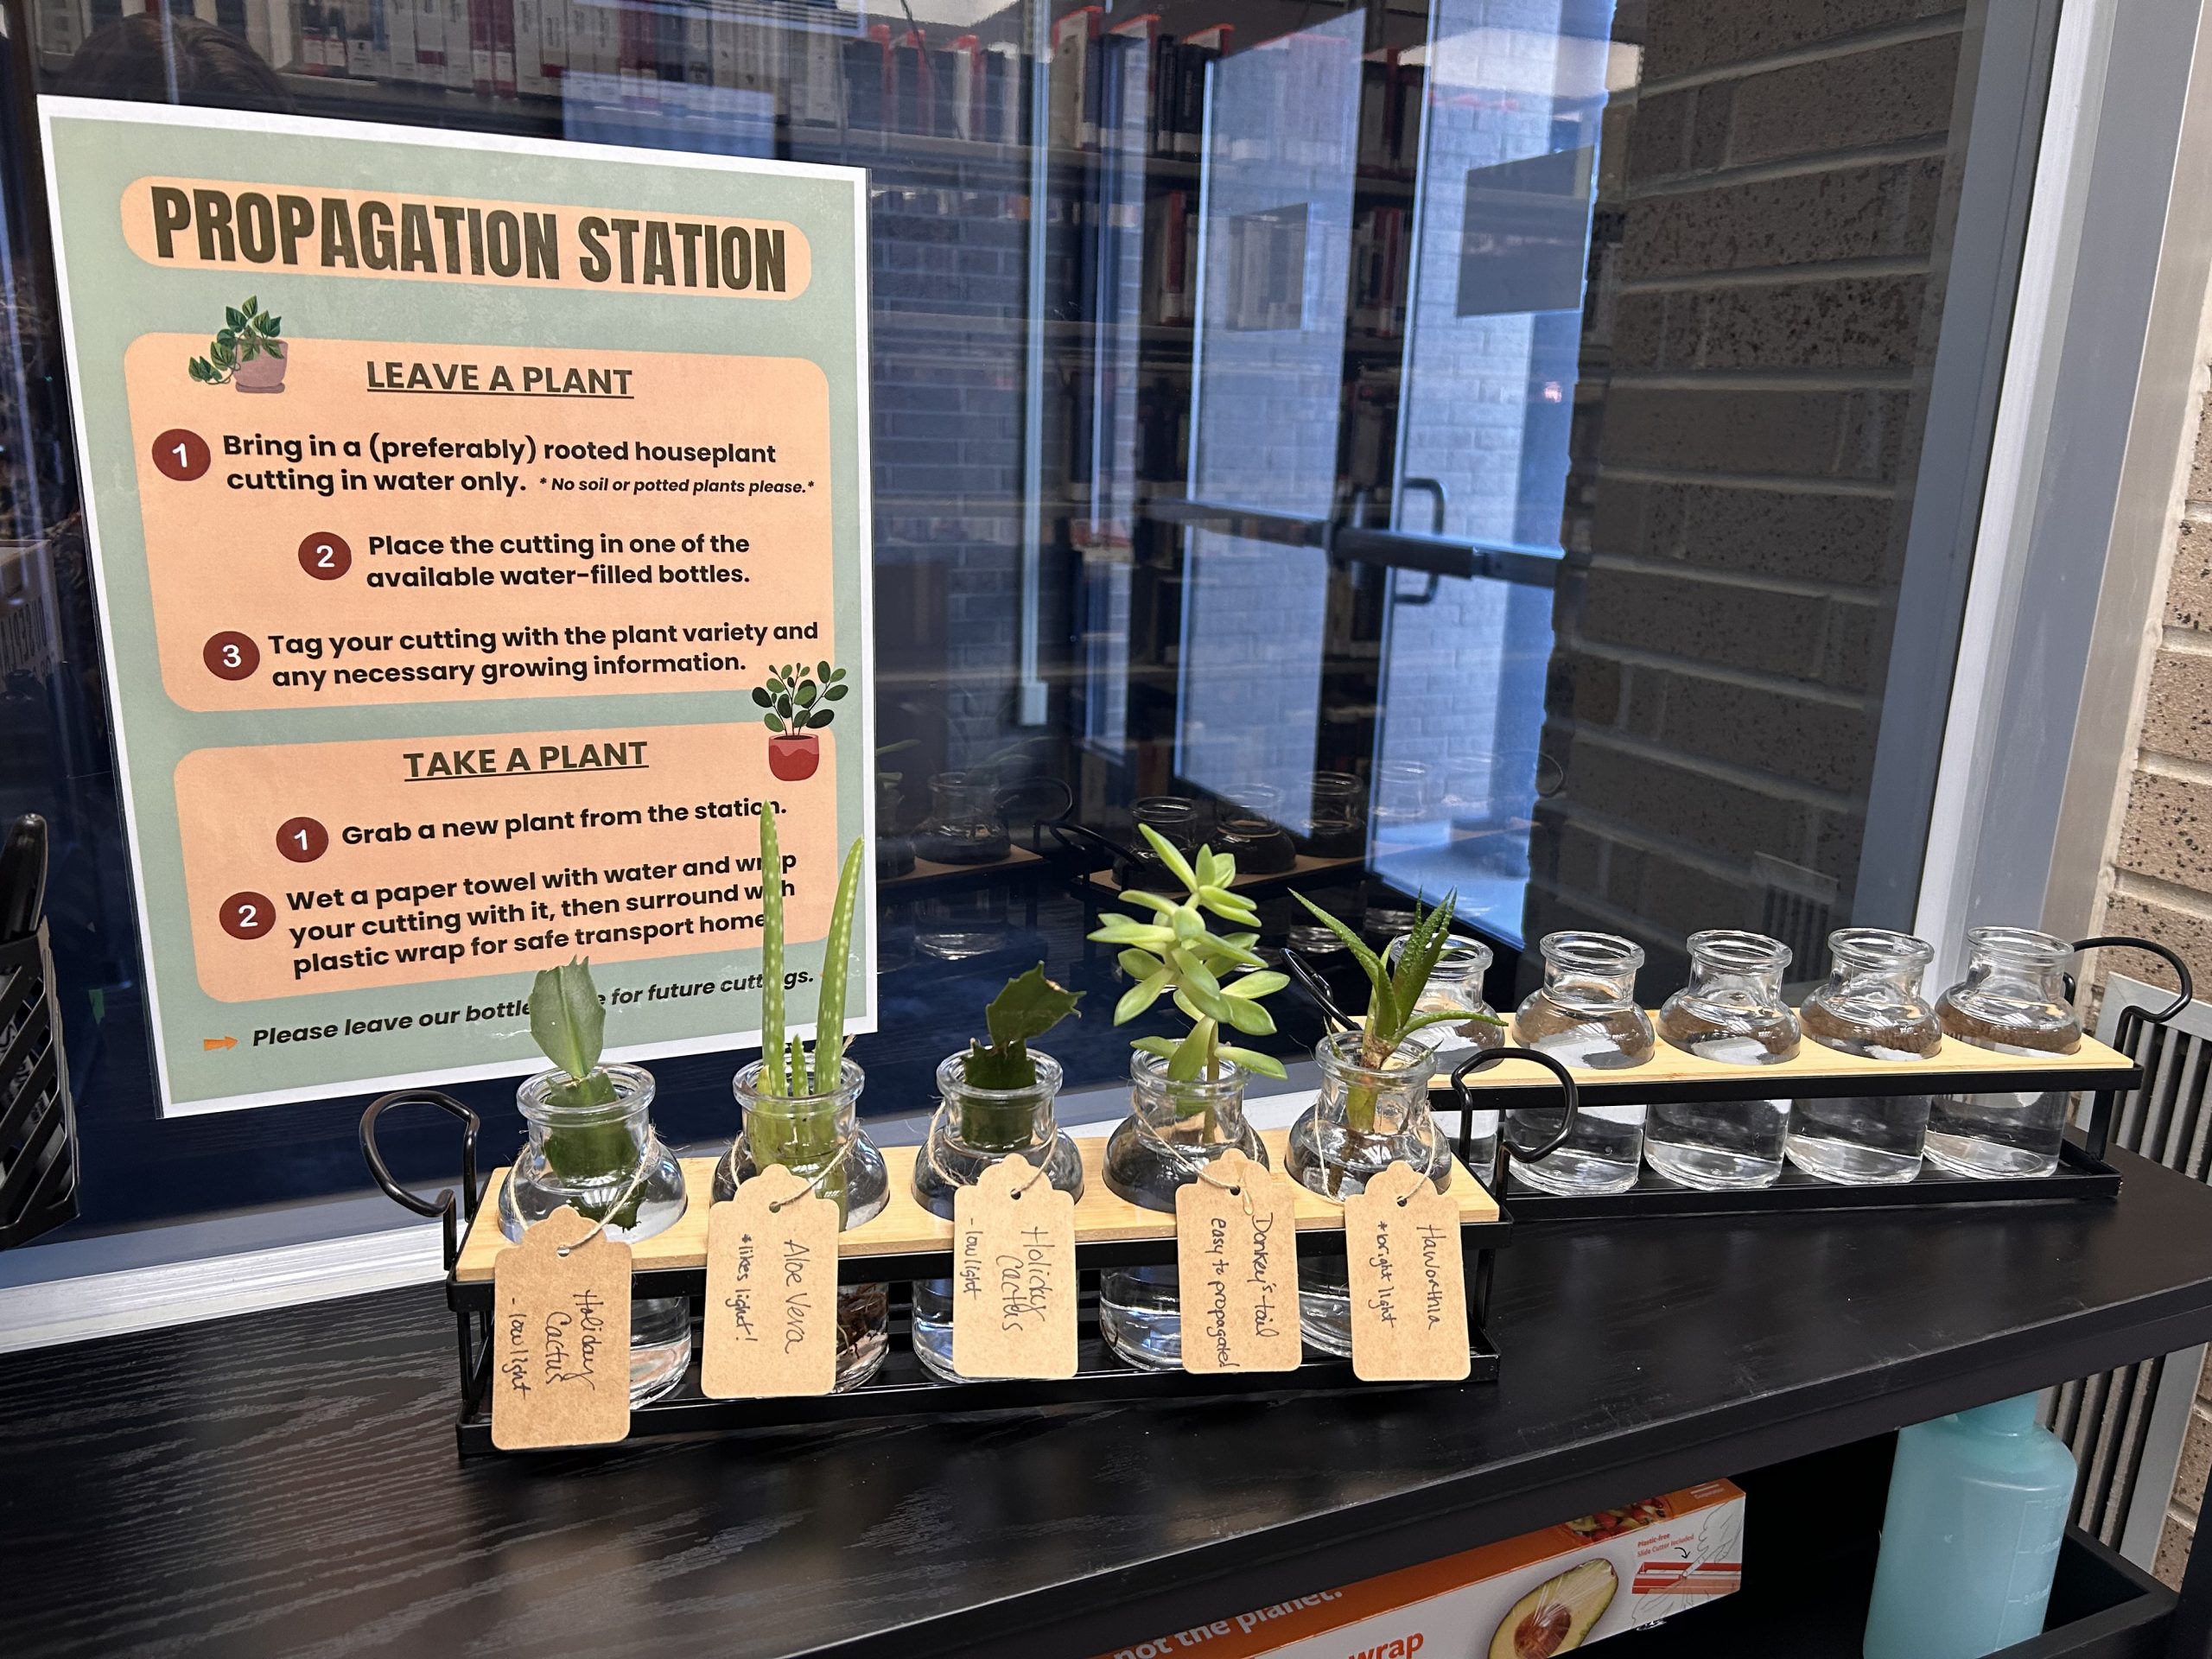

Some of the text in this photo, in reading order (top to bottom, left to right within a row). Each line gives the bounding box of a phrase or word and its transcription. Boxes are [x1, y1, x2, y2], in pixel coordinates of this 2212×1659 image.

[152, 187, 785, 292] PROPAGATION STATION
[367, 361, 632, 394] LEAVE A PLANT
[172, 442, 188, 467] 1
[224, 433, 775, 467] Bring in a (preferably) rooted houseplant
[227, 468, 525, 497] cutting in water only.
[552, 479, 575, 490] No
[579, 478, 608, 491] soil
[613, 480, 630, 491] or
[633, 480, 690, 493] potted
[693, 480, 745, 495] plants
[316, 544, 335, 568] 2
[369, 533, 749, 559] Place the cutting in one of the
[367, 564, 749, 588] available water-filled bottles.
[222, 644, 242, 668] 3
[268, 622, 817, 659] Tag your cutting with the plant variety and
[273, 652, 746, 691] any necessary growing information.
[404, 741, 647, 777] TAKE A PLANT
[294, 830, 308, 851] 1
[342, 823, 411, 844] Grab
[418, 824, 435, 839] a
[442, 820, 498, 837] new
[505, 812, 575, 839] plant
[581, 809, 641, 827] from
[648, 804, 689, 822] the
[286, 855, 797, 910] Wet a paper towel with water and wrp
[238, 904, 258, 927] 2
[289, 880, 795, 949] your cutting with it, then surround wh
[294, 947, 389, 980] plastic
[395, 944, 465, 963] wrap
[471, 937, 507, 956] for
[514, 930, 569, 950] safe
[575, 918, 694, 944] transport
[612, 988, 643, 1005] for
[648, 982, 715, 1001] future
[721, 971, 814, 992] cuttgs.
[253, 1025, 338, 1046] Please
[345, 1016, 412, 1035] leave
[419, 1011, 461, 1027] our
[964, 1230, 984, 1257] low
[960, 1260, 982, 1300] light
[1247, 1211, 1280, 1338] Donkey's tail
[784, 1239, 811, 1354] Aloe Vera
[1205, 1217, 1240, 1368] easy to propagate!
[509, 1313, 527, 1346] low
[563, 1289, 604, 1391] Holiday
[545, 1311, 572, 1385] Cactus
[502, 1350, 531, 1401] light
[1114, 1637, 1173, 1659] not
